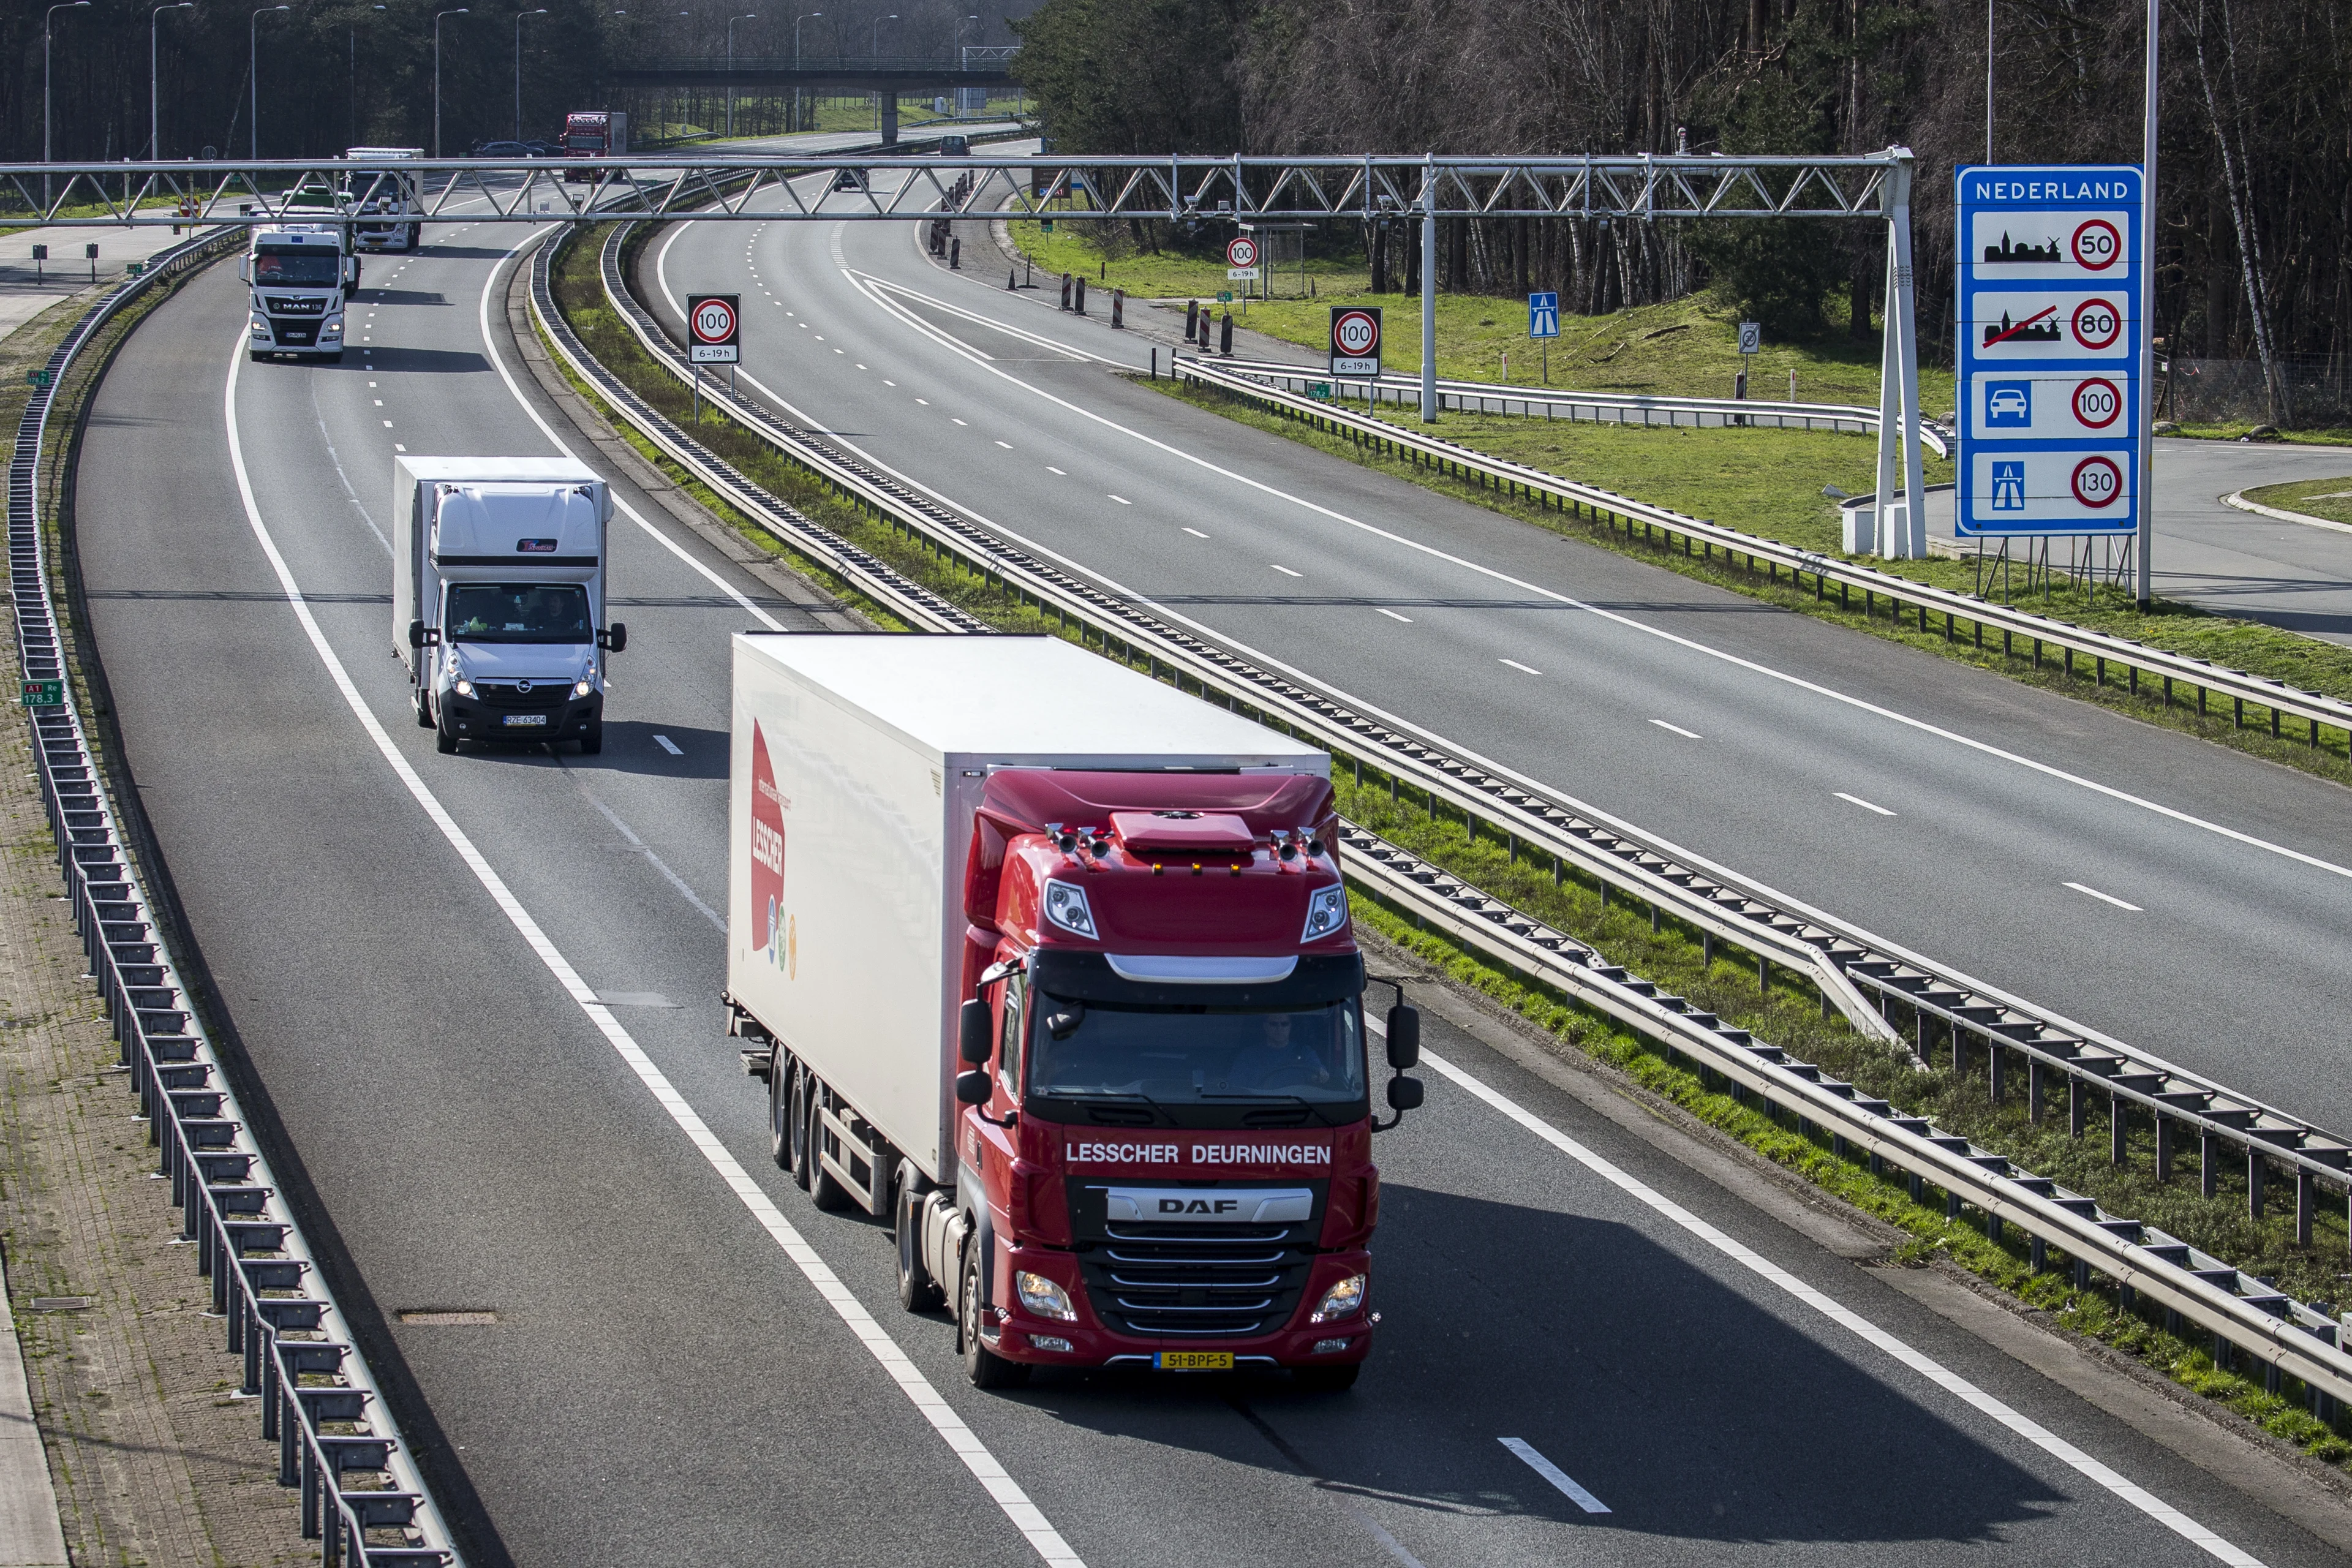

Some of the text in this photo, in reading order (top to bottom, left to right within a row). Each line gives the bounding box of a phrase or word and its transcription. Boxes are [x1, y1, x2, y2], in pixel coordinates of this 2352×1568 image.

[1977, 183, 2127, 199] NEDERLAND
[1233, 247, 1253, 259] 100
[2081, 235, 2113, 254] 50
[699, 313, 728, 330] 100
[2081, 314, 2113, 333] 80
[1342, 326, 1370, 342] 100
[2081, 393, 2113, 413] 100
[2081, 473, 2113, 491] 130
[24, 694, 53, 704] 178,3
[753, 815, 783, 877] LESSCHER
[1066, 1144, 1330, 1164] LESSCHER DEURNINGEN
[1158, 1199, 1238, 1214] DAF
[1169, 1354, 1227, 1366] 51-BPF-5
